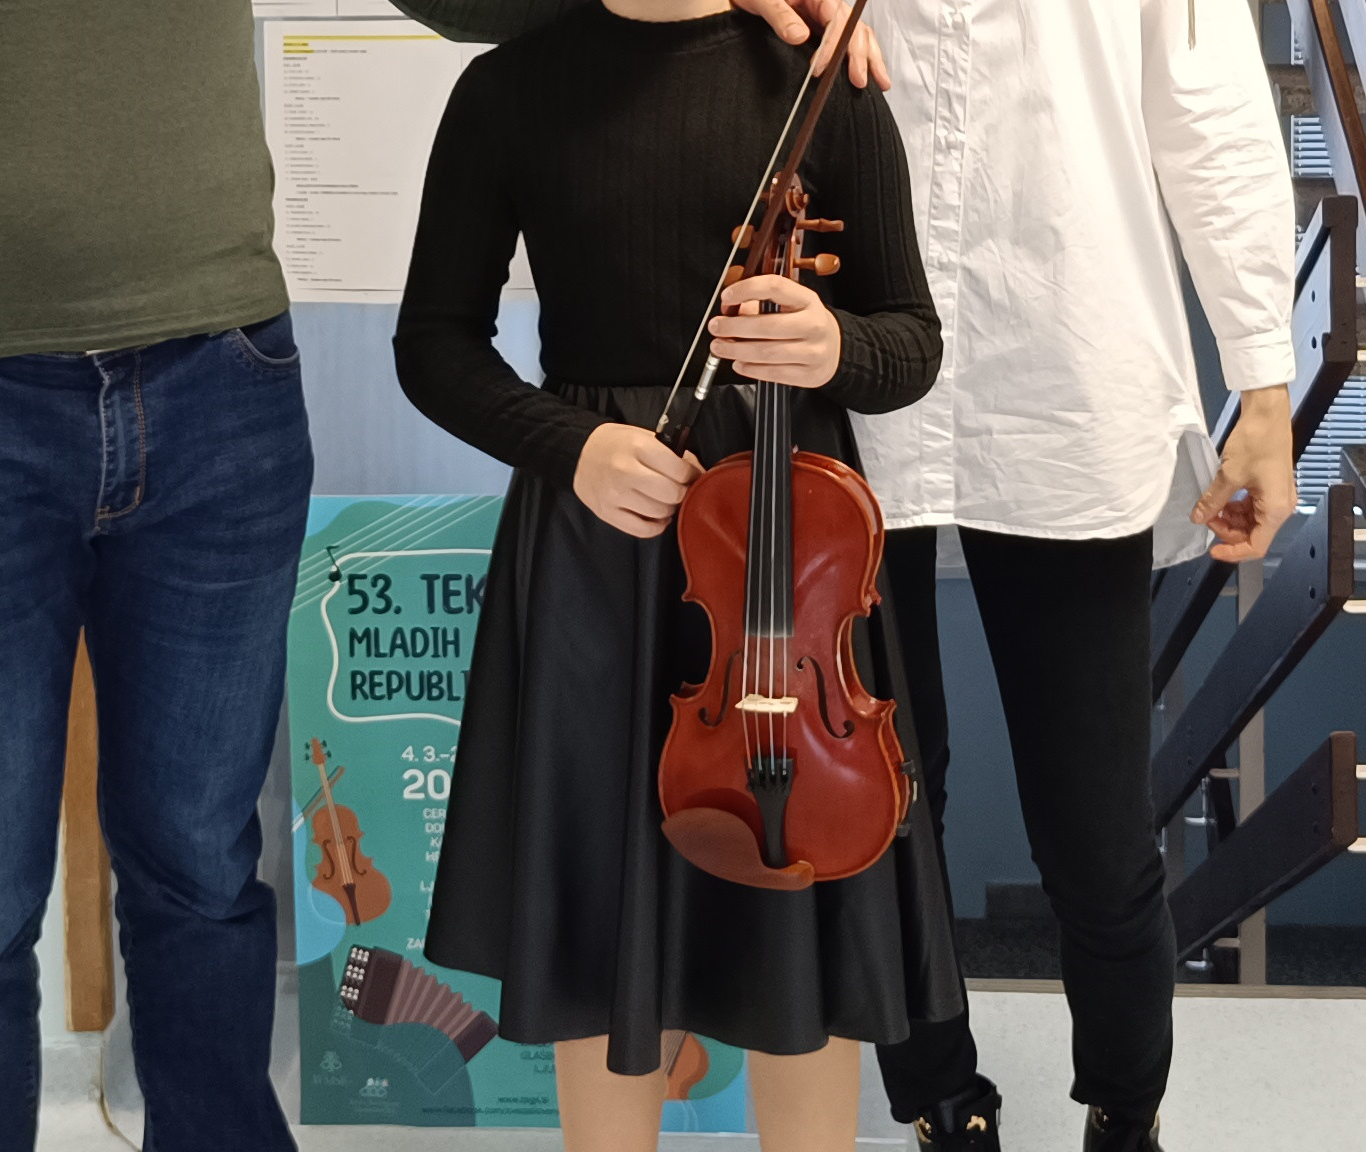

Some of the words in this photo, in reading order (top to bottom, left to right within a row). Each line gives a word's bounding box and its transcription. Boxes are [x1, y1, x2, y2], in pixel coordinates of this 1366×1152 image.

[347, 573, 402, 615] 53.
[349, 626, 460, 658] MLADIH
[401, 745, 419, 761] 4.
